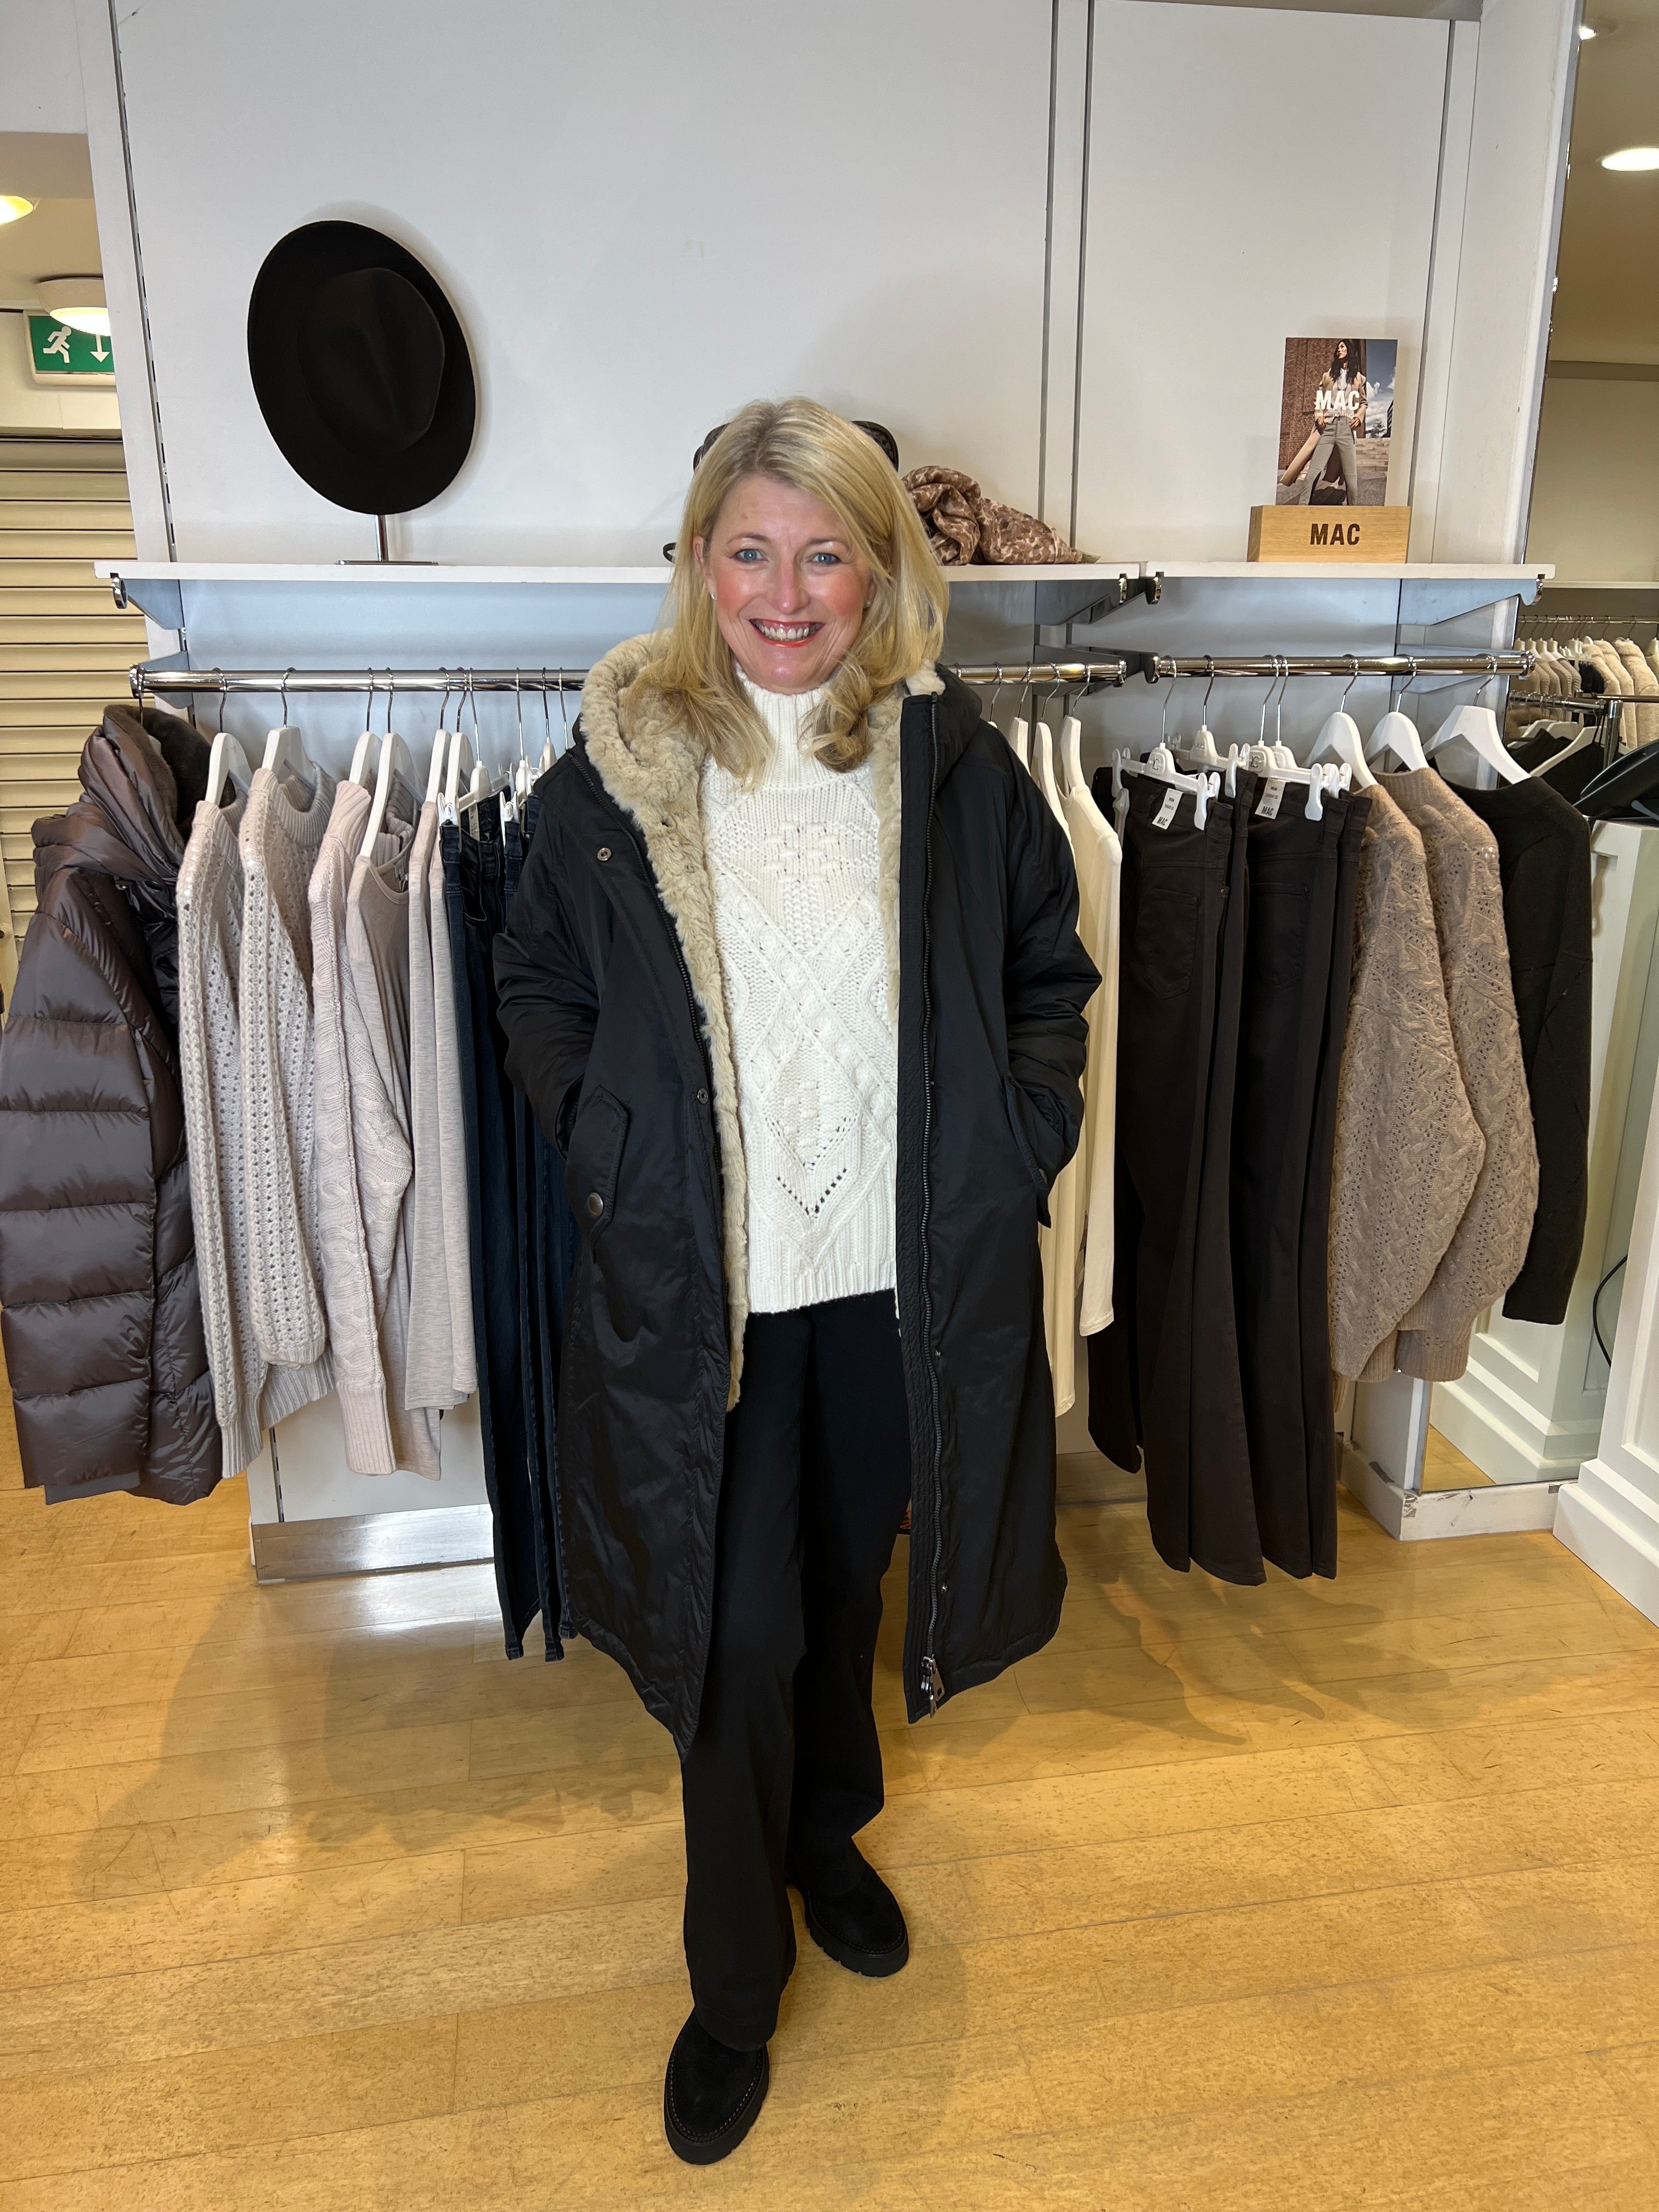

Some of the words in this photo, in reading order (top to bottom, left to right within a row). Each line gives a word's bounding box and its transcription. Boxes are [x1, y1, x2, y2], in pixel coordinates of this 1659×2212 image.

[1314, 390, 1360, 410] MAC
[1310, 523, 1361, 545] MAC
[1261, 806, 1274, 816] MAC
[1156, 816, 1168, 826] MAC
